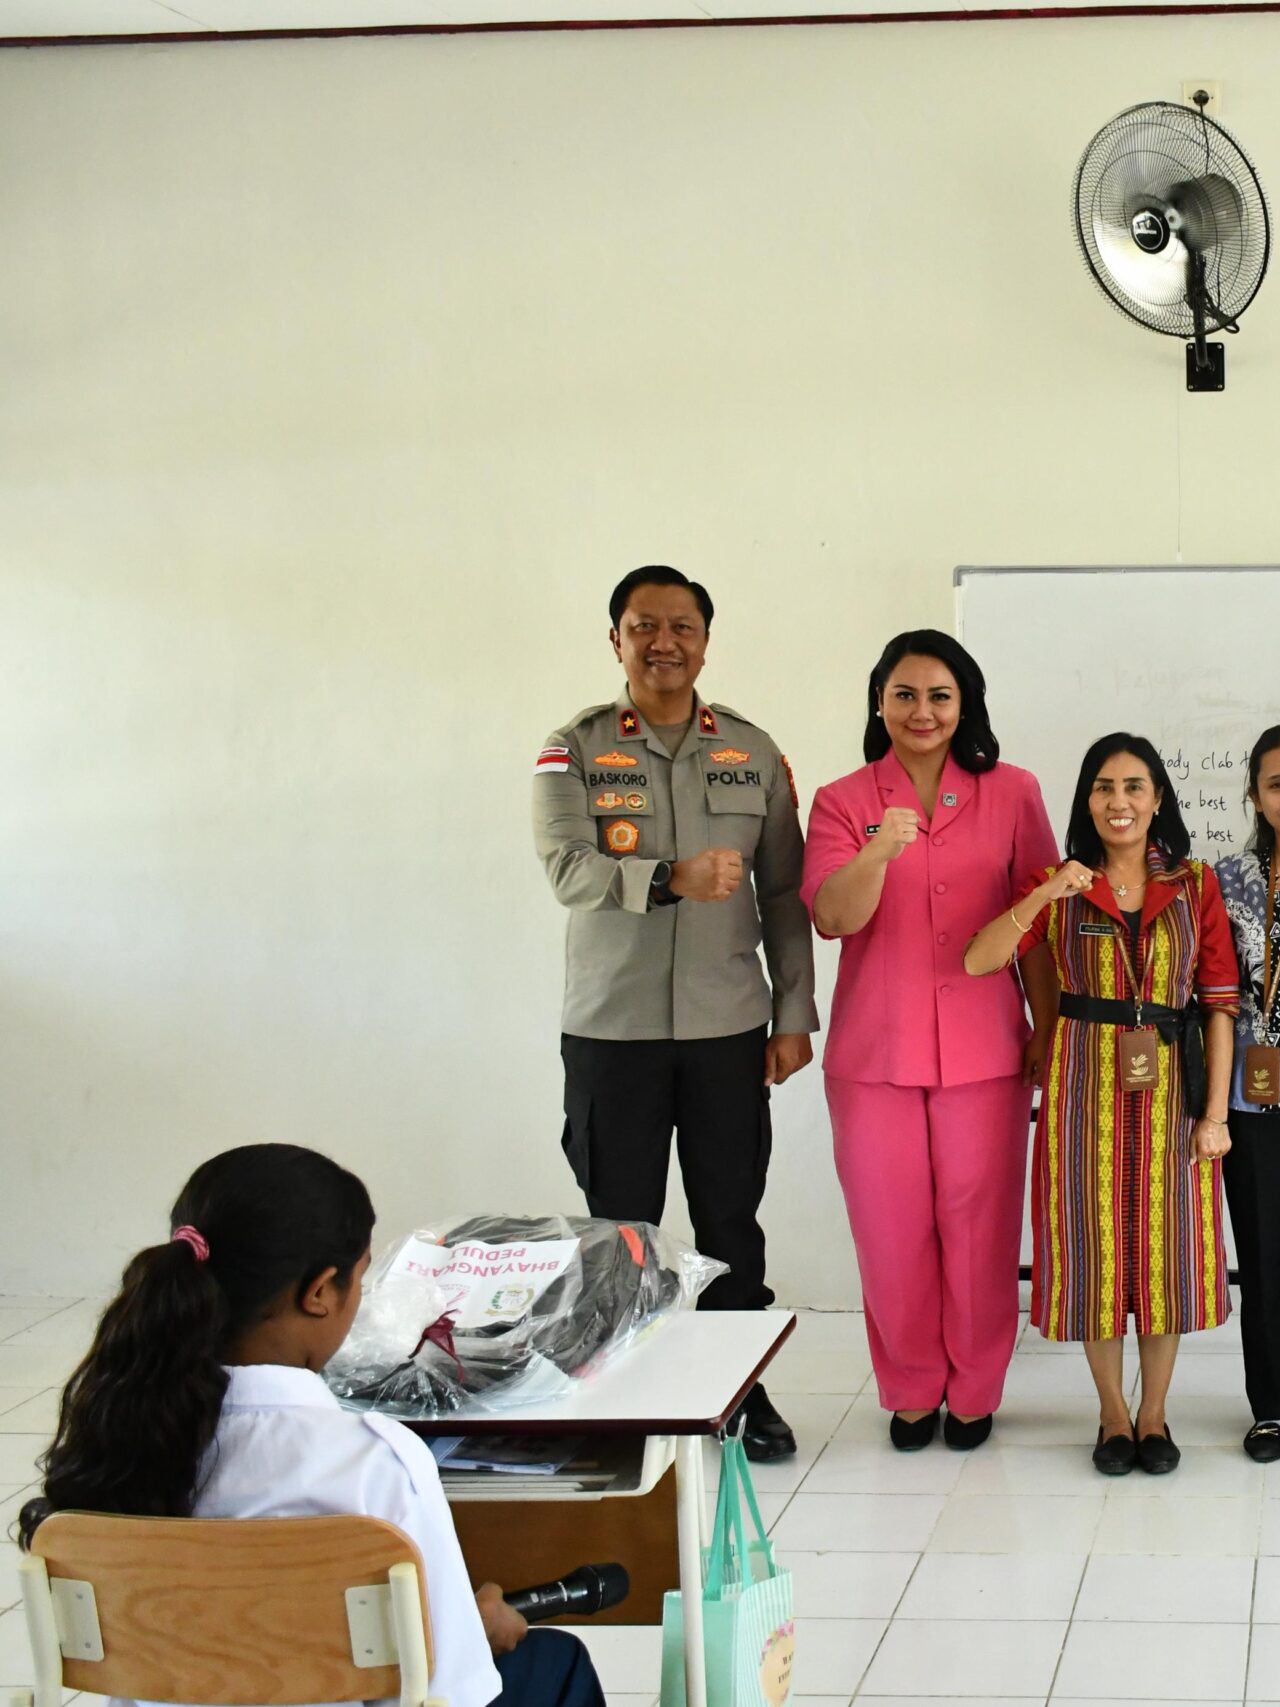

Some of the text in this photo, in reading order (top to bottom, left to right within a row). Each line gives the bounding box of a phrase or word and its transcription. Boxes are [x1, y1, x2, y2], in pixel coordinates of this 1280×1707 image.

[589, 772, 648, 787] BASKORO
[706, 771, 761, 786] POLRI
[1199, 789, 1228, 812] best
[1206, 821, 1235, 843] best
[450, 1246, 527, 1261] PEDULI
[407, 1259, 561, 1278] BHAYANGKARI
